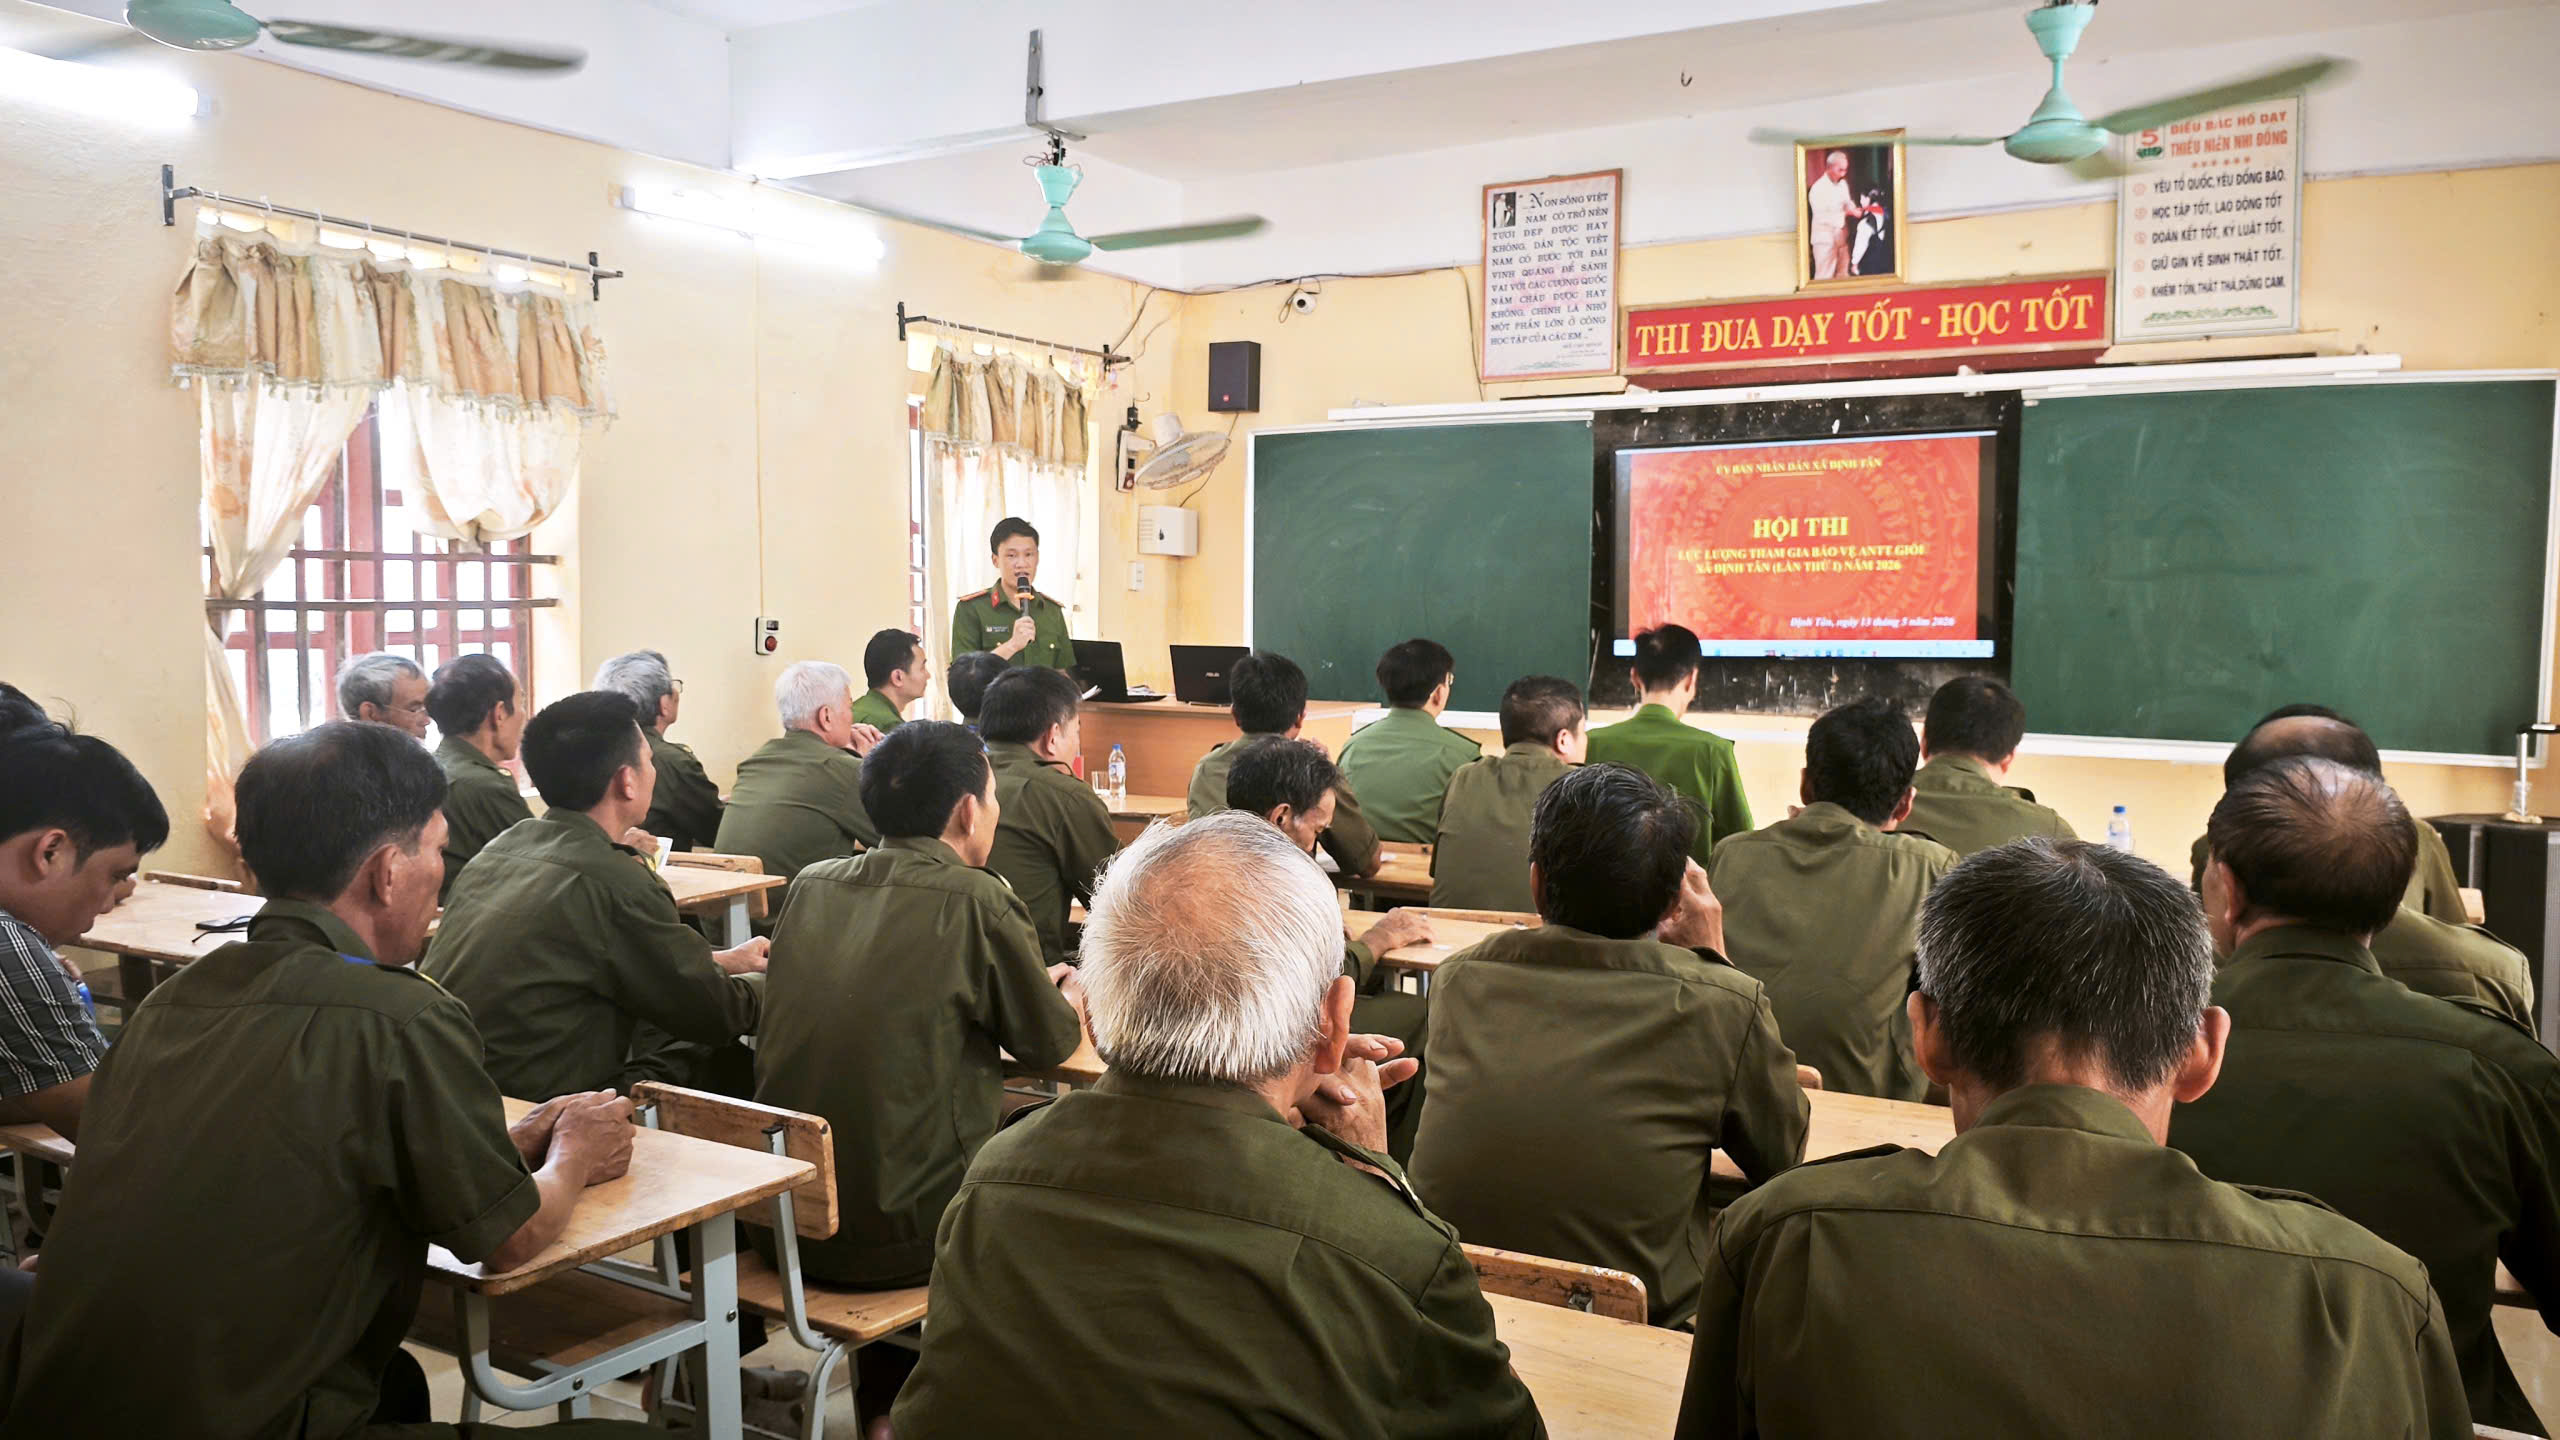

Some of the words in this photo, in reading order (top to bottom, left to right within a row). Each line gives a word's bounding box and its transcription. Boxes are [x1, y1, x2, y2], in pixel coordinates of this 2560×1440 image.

[2152, 207, 2171, 220] HỌC
[2215, 200, 2233, 214] LAO
[1526, 214, 1547, 224] NAM
[1586, 221, 1608, 231] HAY
[1492, 257, 1513, 266] NAM
[2207, 253, 2230, 266] SINH
[1492, 270, 1516, 279] VINH
[1522, 266, 1555, 277] QUANG
[1491, 283, 1508, 293] VAI
[1586, 289, 1607, 298] HAY
[1636, 322, 1691, 357] THI
[1701, 318, 1763, 353] ĐUA
[1771, 312, 1834, 355] DẠY
[1845, 298, 1912, 343] TỐT
[1938, 300, 2011, 345] HỌC
[2021, 284, 2093, 333] TỐT
[1753, 515, 1798, 542] HỘI
[1804, 516, 1849, 537] THI
[1749, 547, 1786, 559] THAM
[1786, 546, 1810, 558] GIA
